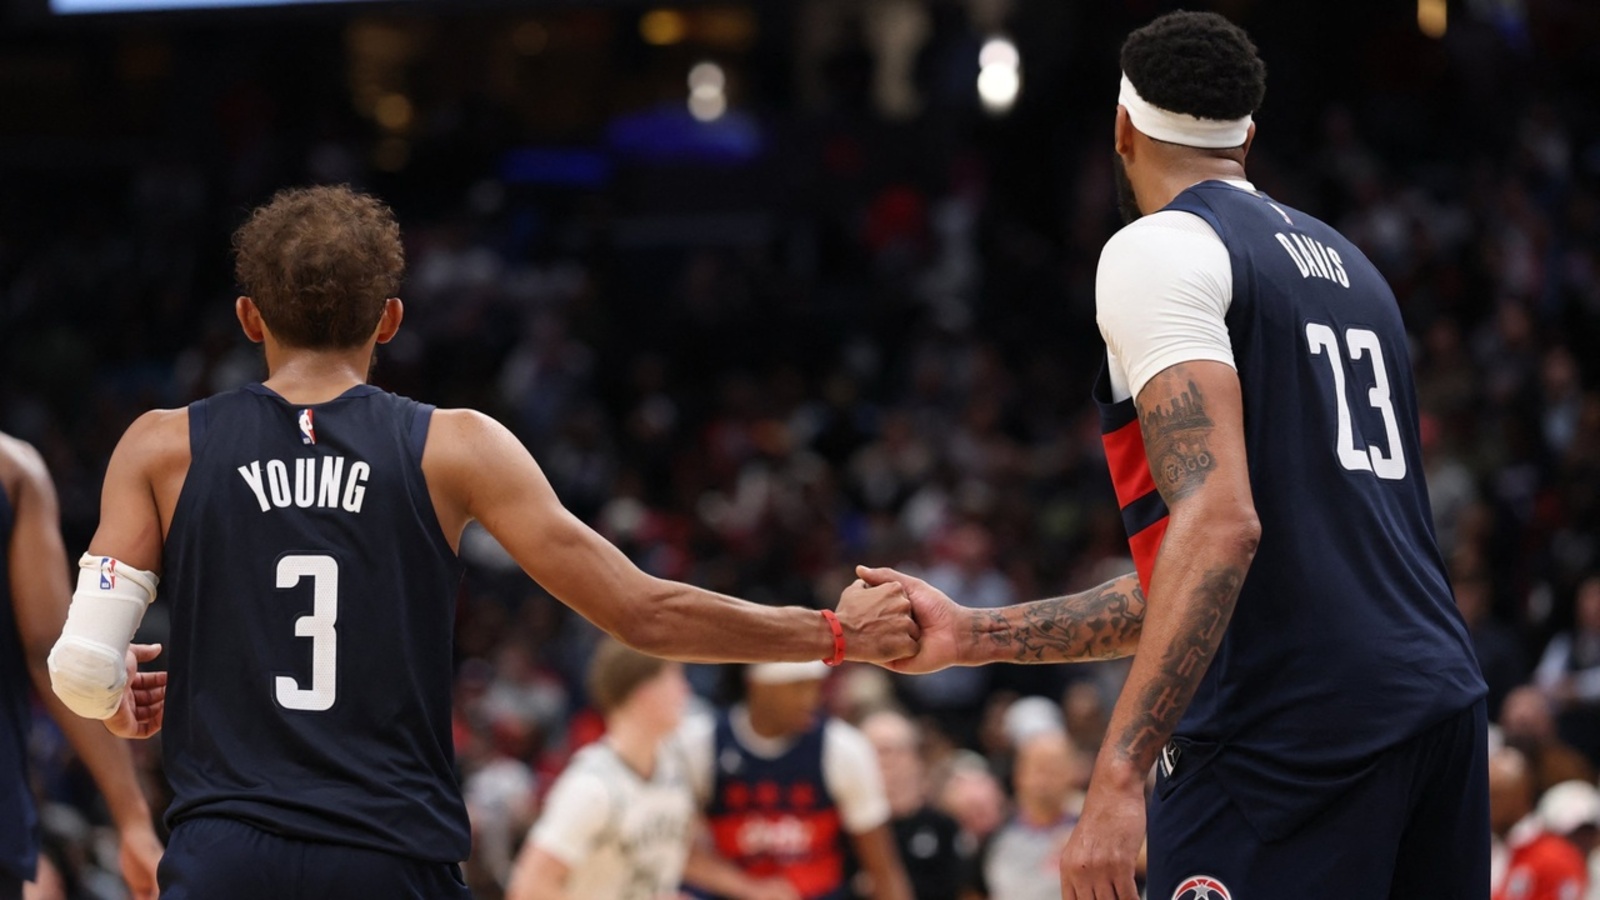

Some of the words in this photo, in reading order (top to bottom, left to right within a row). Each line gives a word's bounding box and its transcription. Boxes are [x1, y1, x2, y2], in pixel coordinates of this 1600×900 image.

[1275, 233, 1349, 288] DAVIS
[1306, 323, 1406, 479] 23
[238, 456, 370, 512] YOUNG
[276, 556, 338, 710] 3
